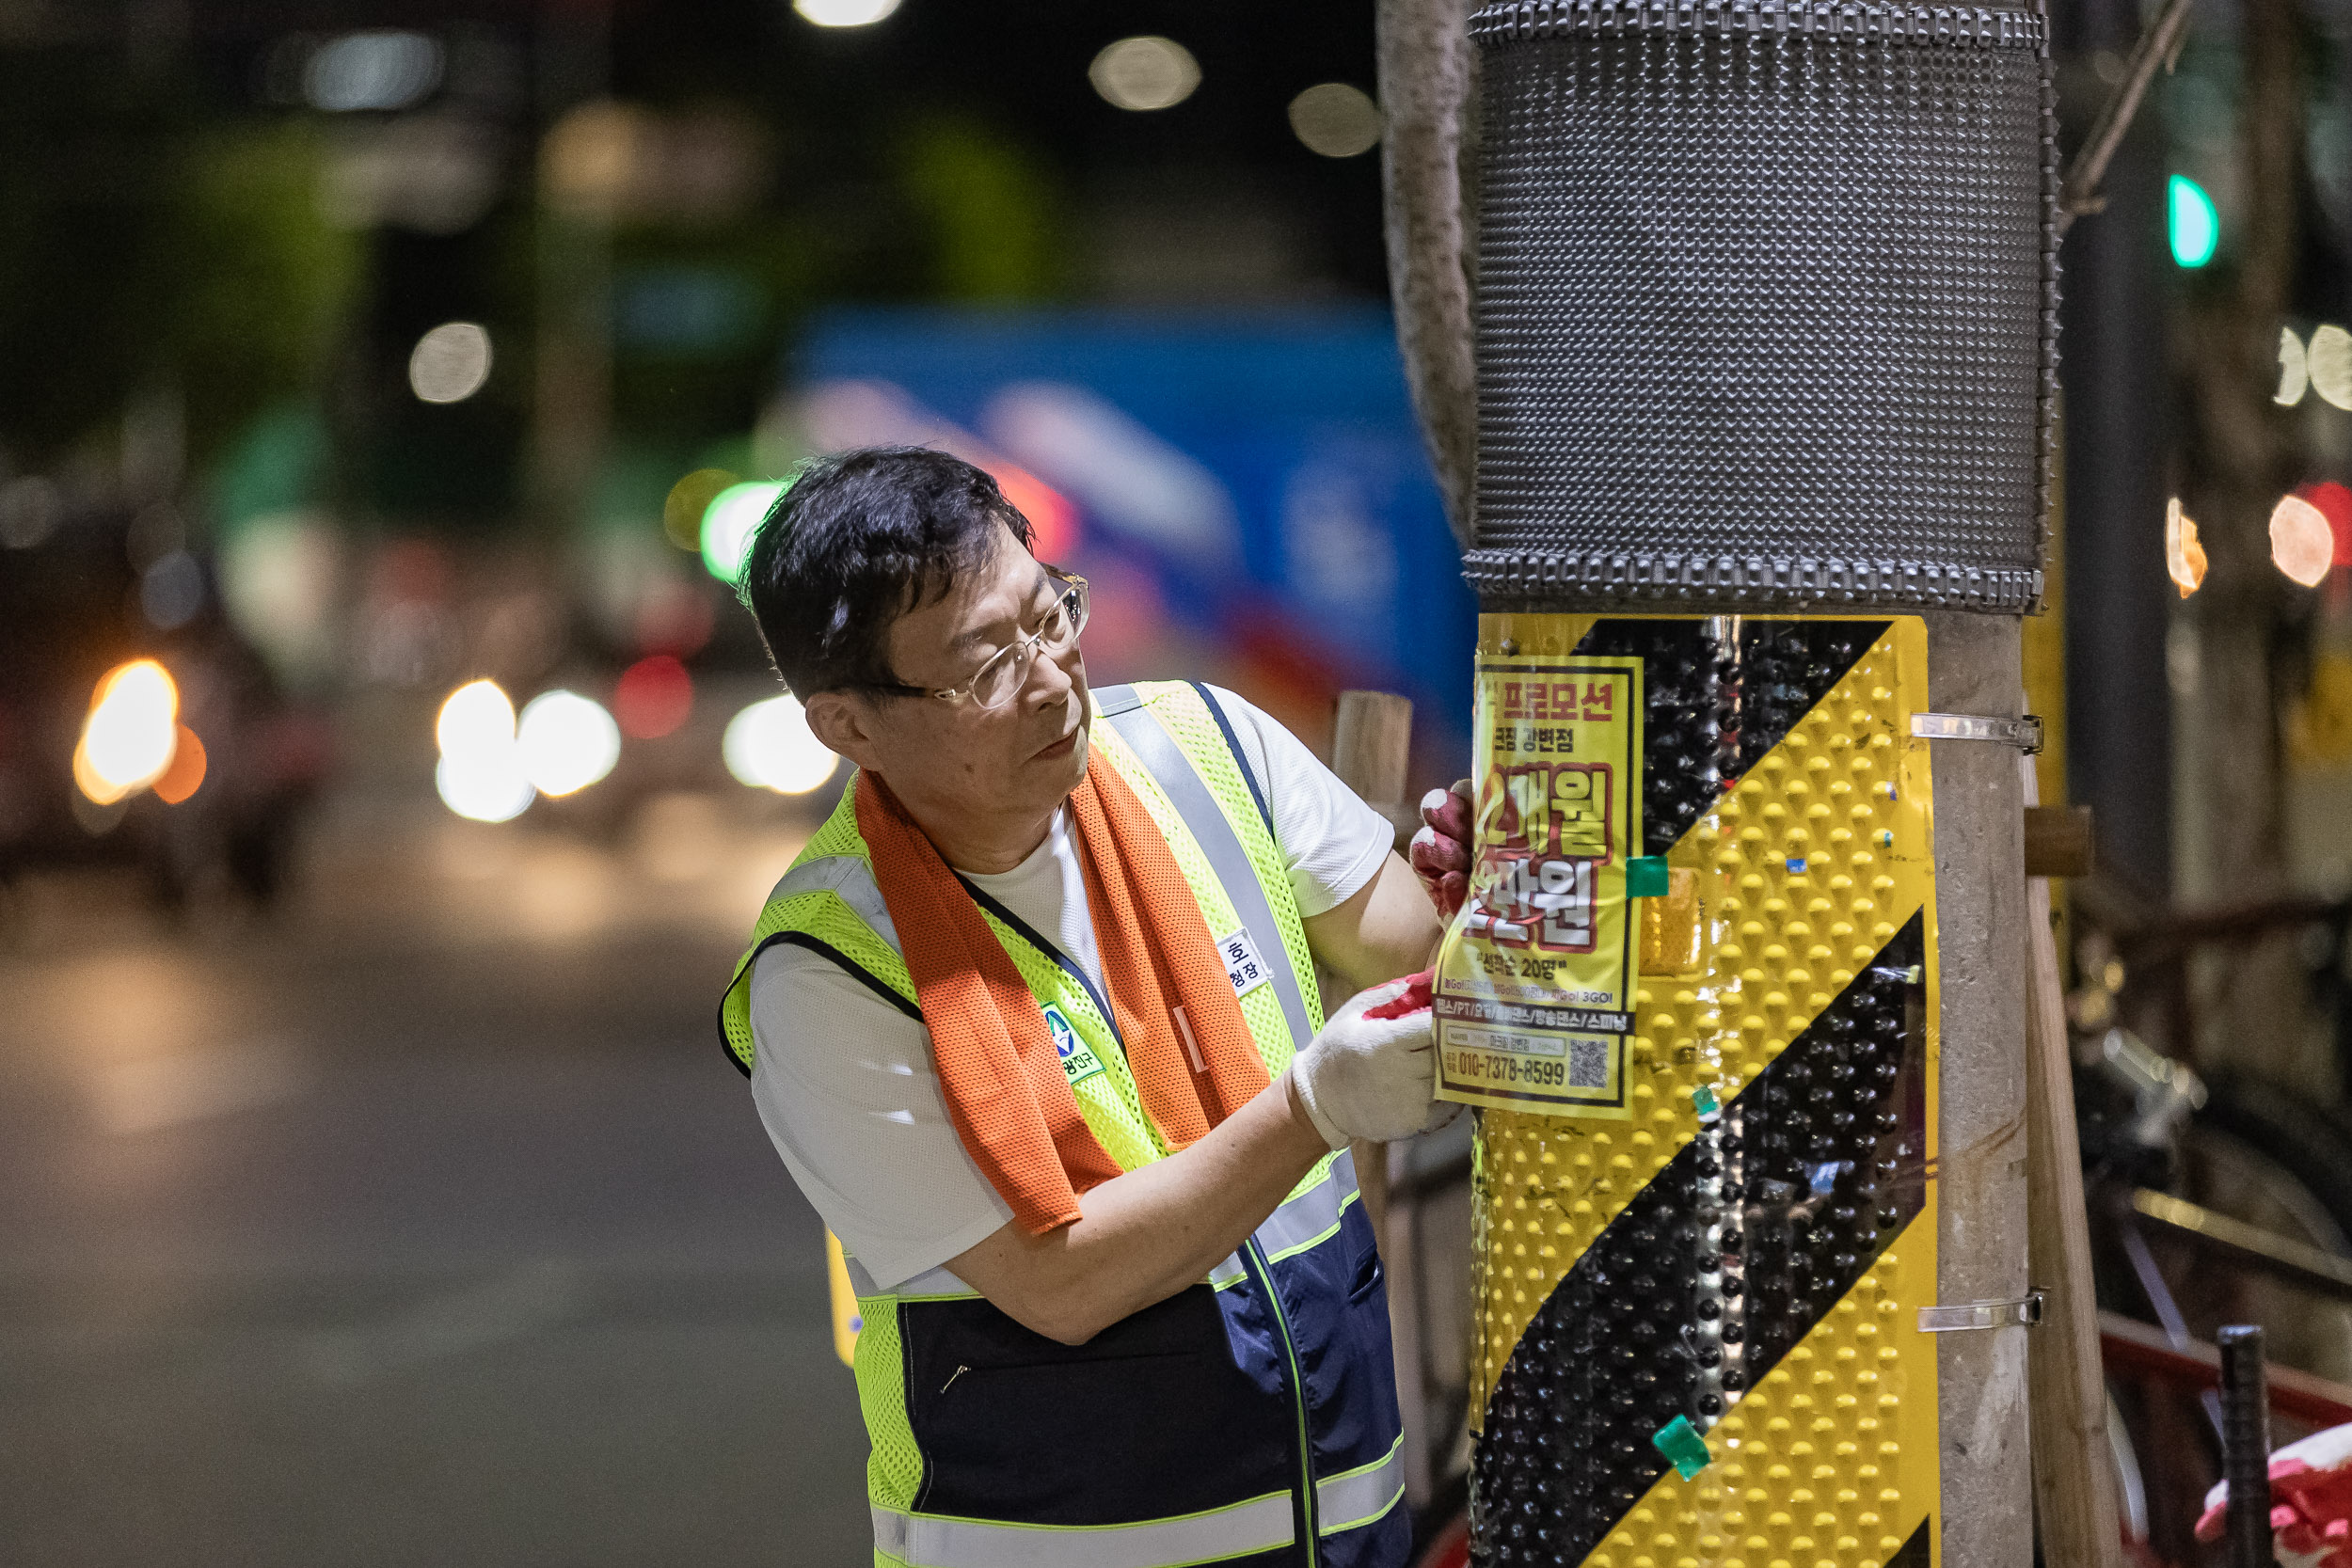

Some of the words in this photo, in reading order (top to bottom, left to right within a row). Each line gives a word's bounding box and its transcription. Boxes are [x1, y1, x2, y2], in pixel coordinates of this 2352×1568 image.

[1503, 682, 1613, 721] 프로모션
[1523, 727, 1574, 752] 강변점
[1458, 1052, 1565, 1085] 010-7378-8599
